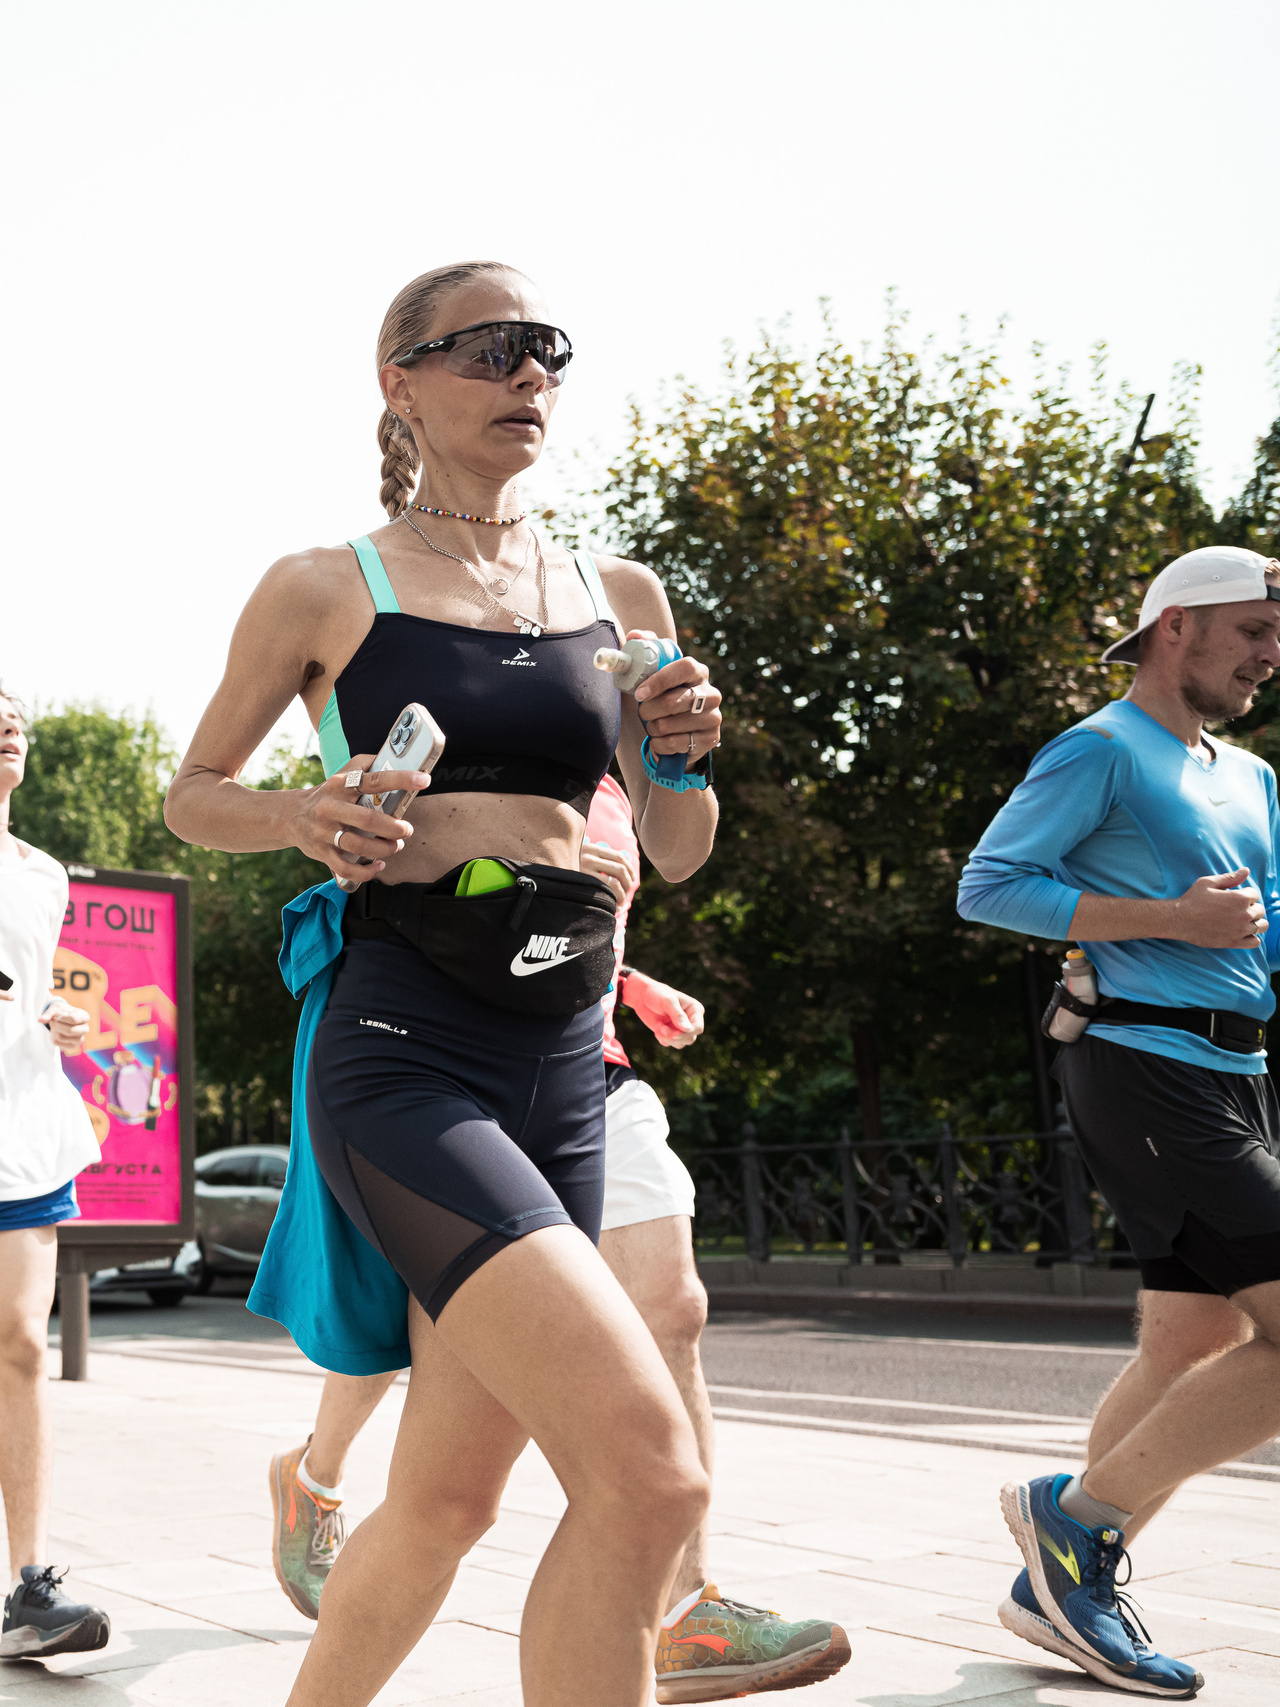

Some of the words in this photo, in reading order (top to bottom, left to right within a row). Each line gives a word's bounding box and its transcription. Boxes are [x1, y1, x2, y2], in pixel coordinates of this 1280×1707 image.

[501, 659, 537, 667] DEMIX
[432, 766, 505, 782] MIX
[86, 902, 155, 934] ГОШ
[523, 934, 570, 960] NIKE
